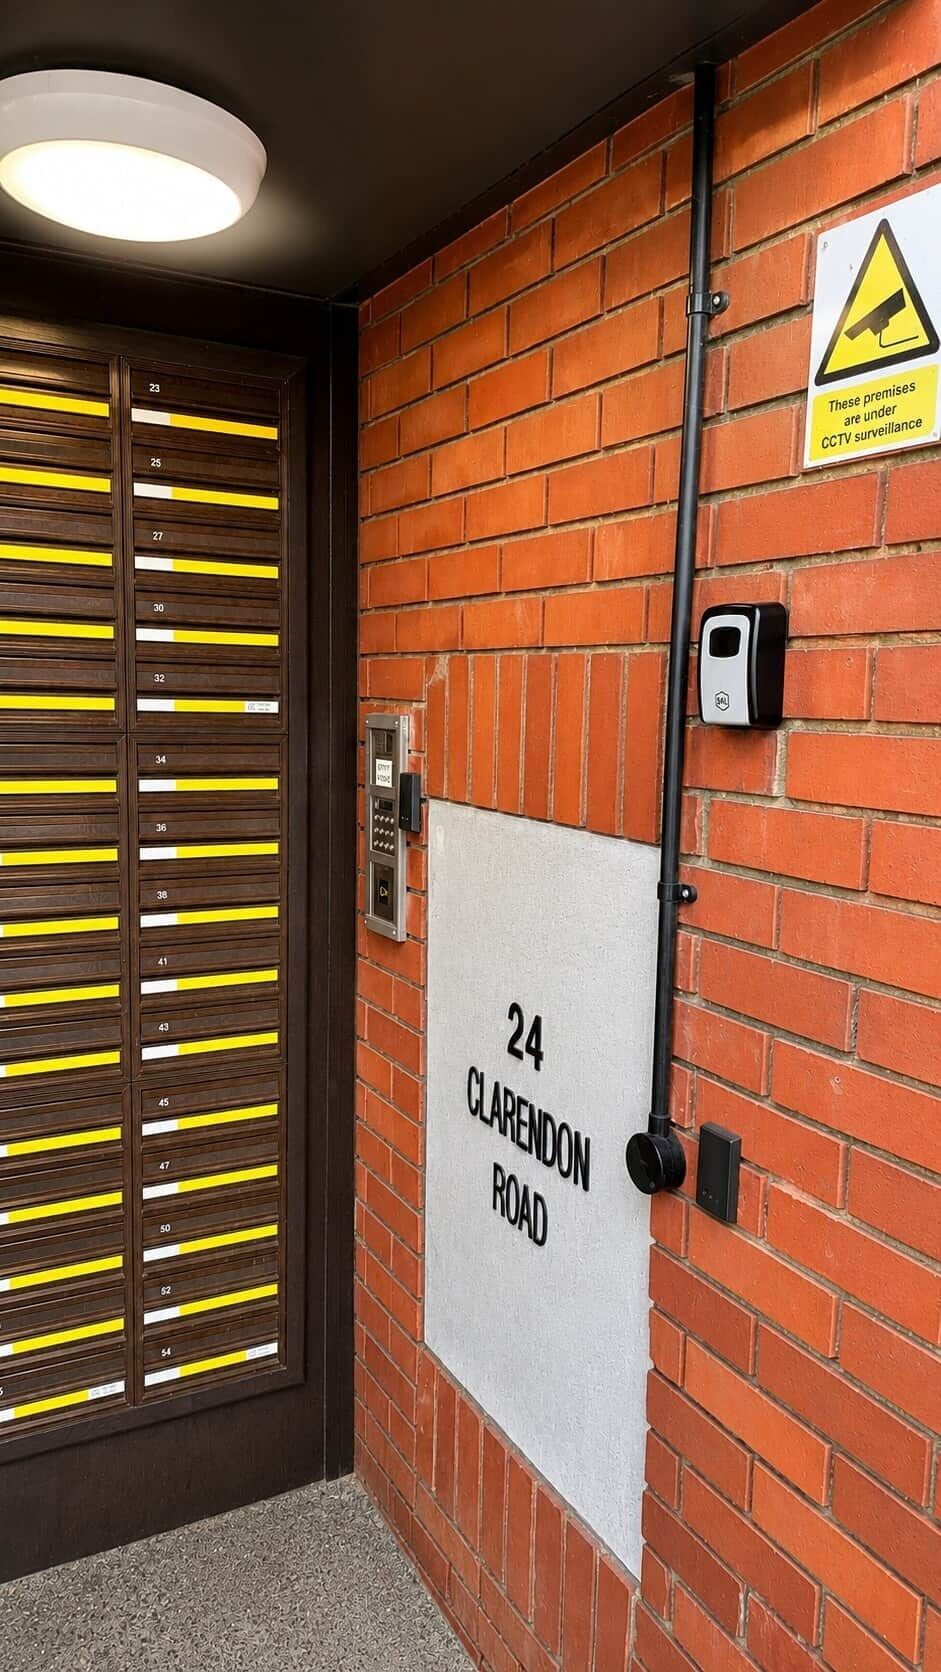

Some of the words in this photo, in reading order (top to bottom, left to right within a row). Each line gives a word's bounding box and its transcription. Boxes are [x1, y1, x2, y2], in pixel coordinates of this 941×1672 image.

[149, 384, 160, 393] 23
[828, 396, 861, 413] These
[864, 382, 916, 407] premises
[844, 413, 861, 427] are
[864, 405, 897, 422] under
[821, 432, 852, 449] CCTV
[854, 418, 923, 442] surveillance
[150, 458, 162, 468] 25
[152, 532, 164, 541] 27
[153, 604, 165, 613] 30
[153, 674, 165, 683] 32
[155, 755, 167, 764] 34
[155, 824, 167, 832] 36
[157, 958, 168, 966] 41
[158, 1023, 169, 1032] 43
[507, 1002, 544, 1072] 24
[158, 1098, 170, 1107] 45
[467, 1066, 590, 1192] CLARENDON
[159, 1161, 170, 1170] 47
[492, 1162, 548, 1246] ROAD
[160, 1224, 171, 1233] 50
[160, 1286, 172, 1296] 52
[161, 1348, 171, 1357] 54
